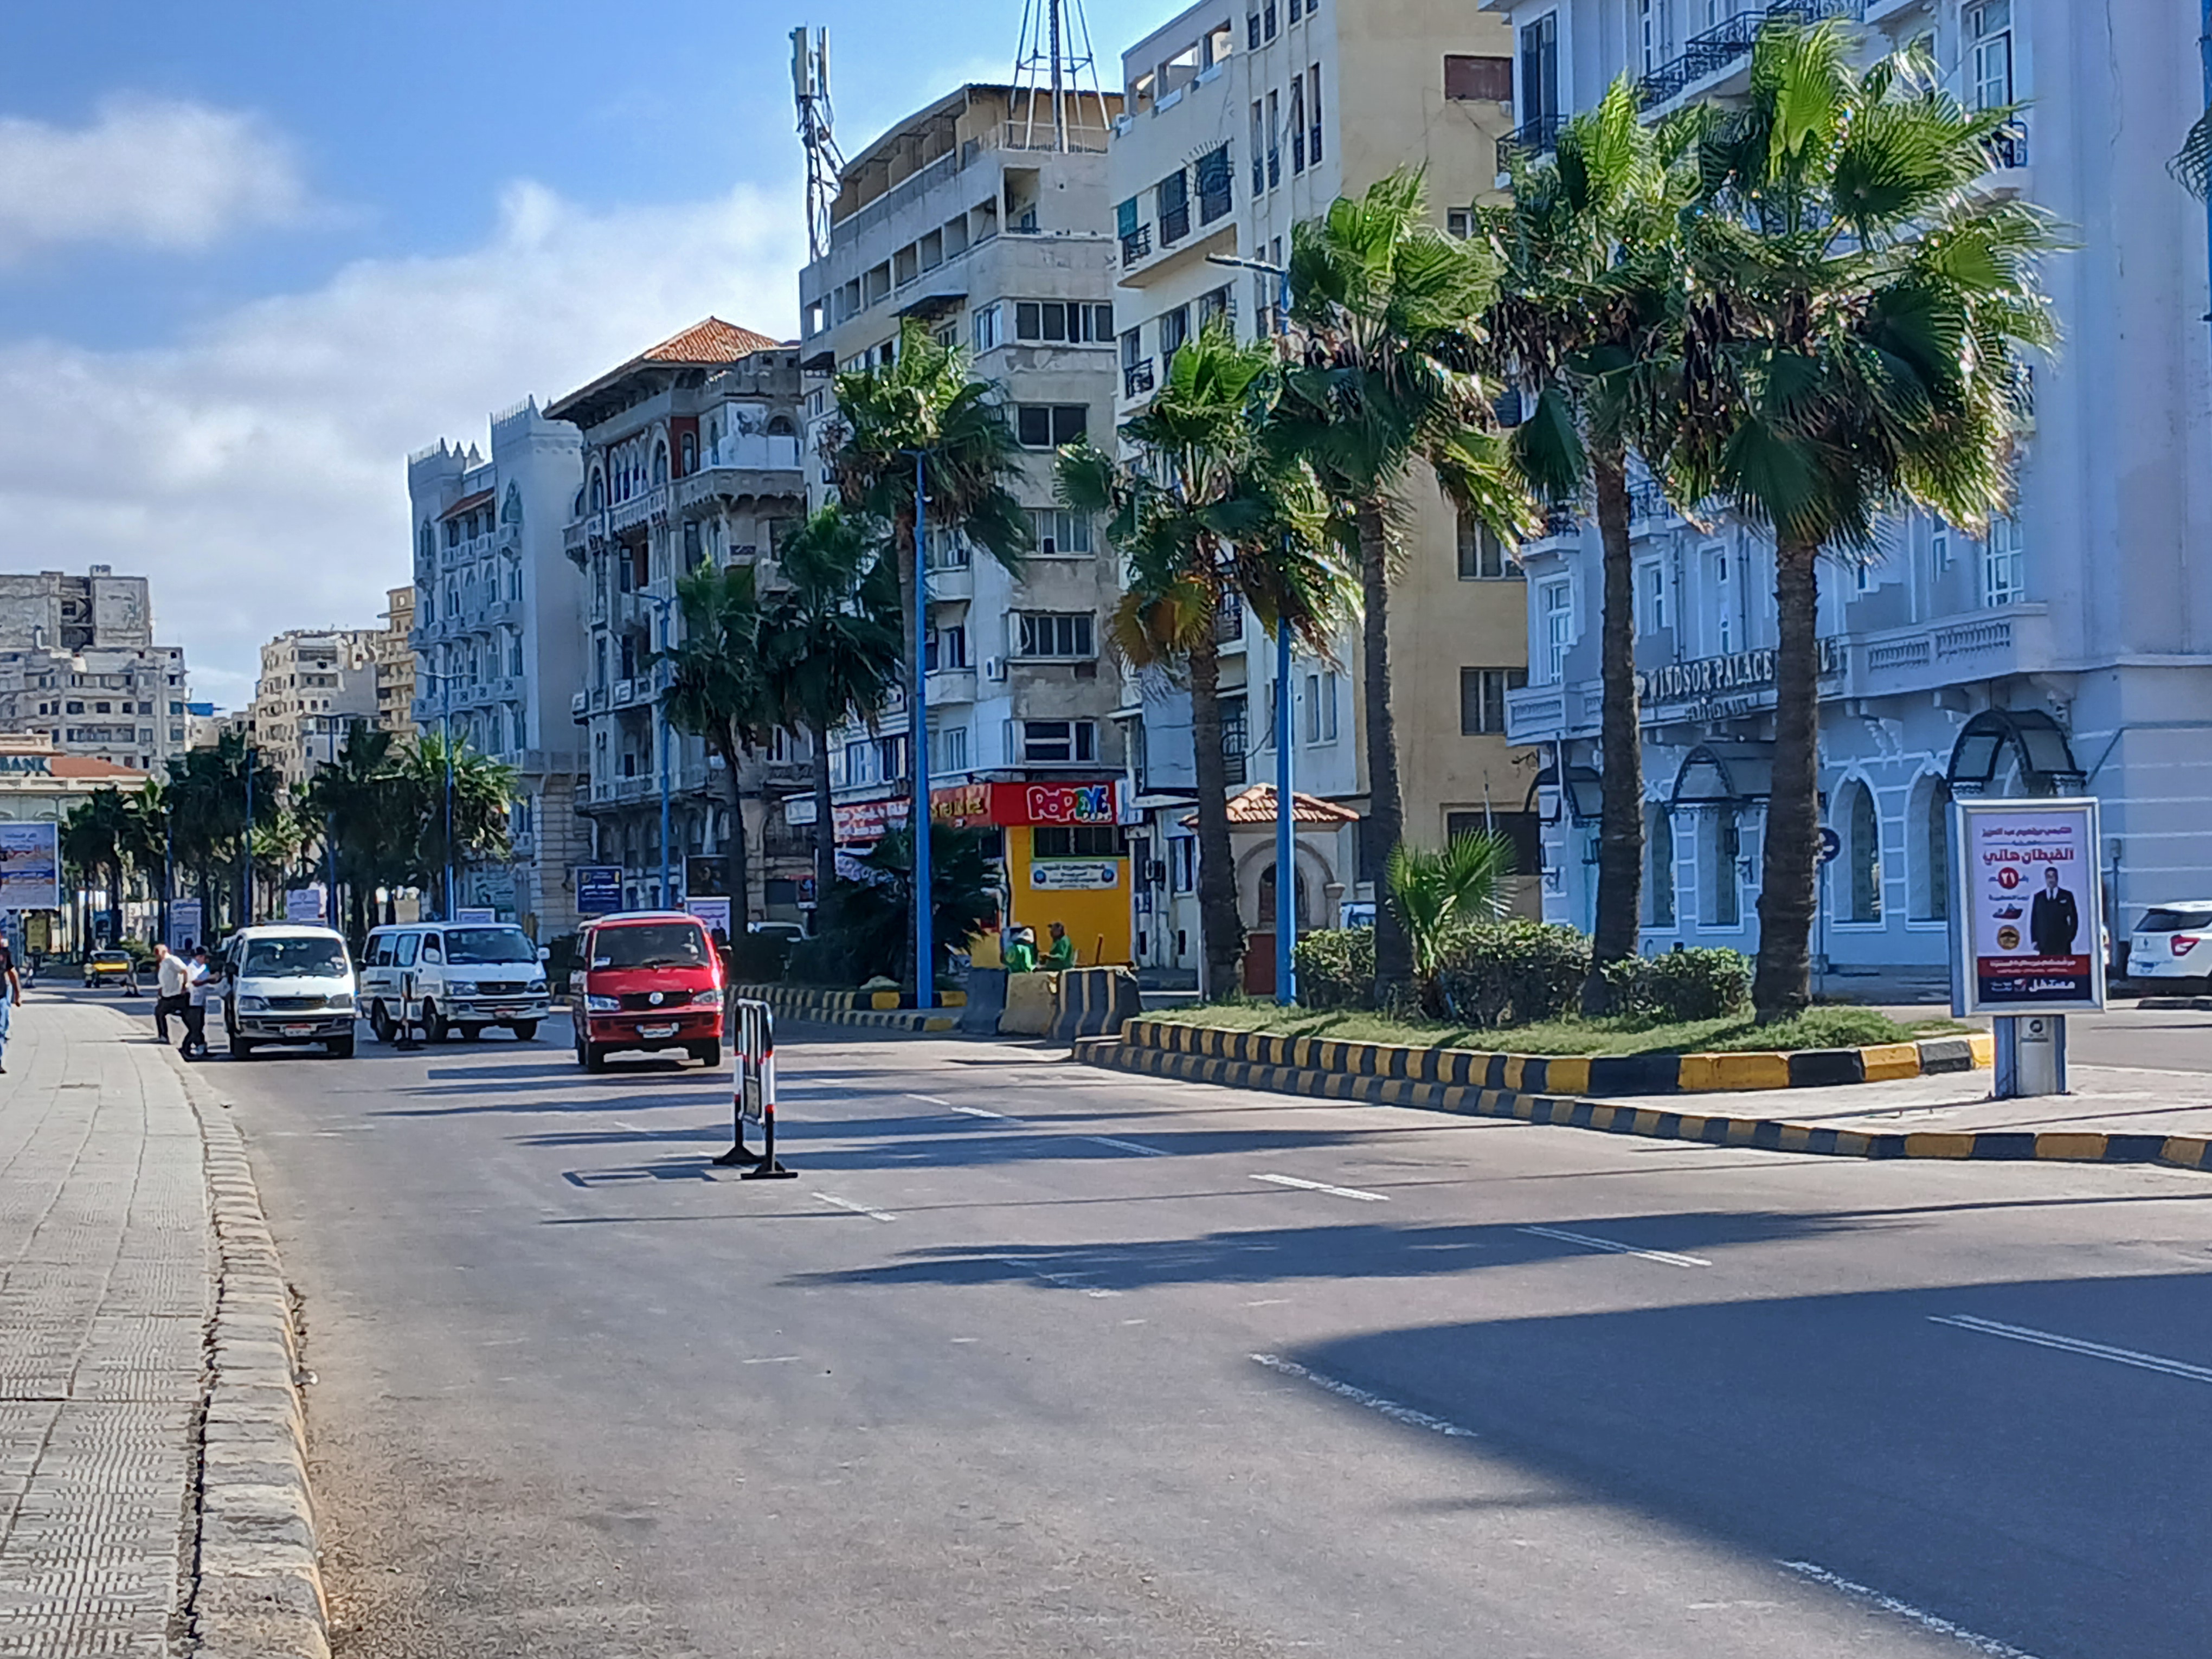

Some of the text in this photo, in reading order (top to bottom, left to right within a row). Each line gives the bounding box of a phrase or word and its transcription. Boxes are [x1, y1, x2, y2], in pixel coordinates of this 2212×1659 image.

[1714, 651, 1773, 689] PALACE
[1982, 848, 2074, 866] القبطان هاني
